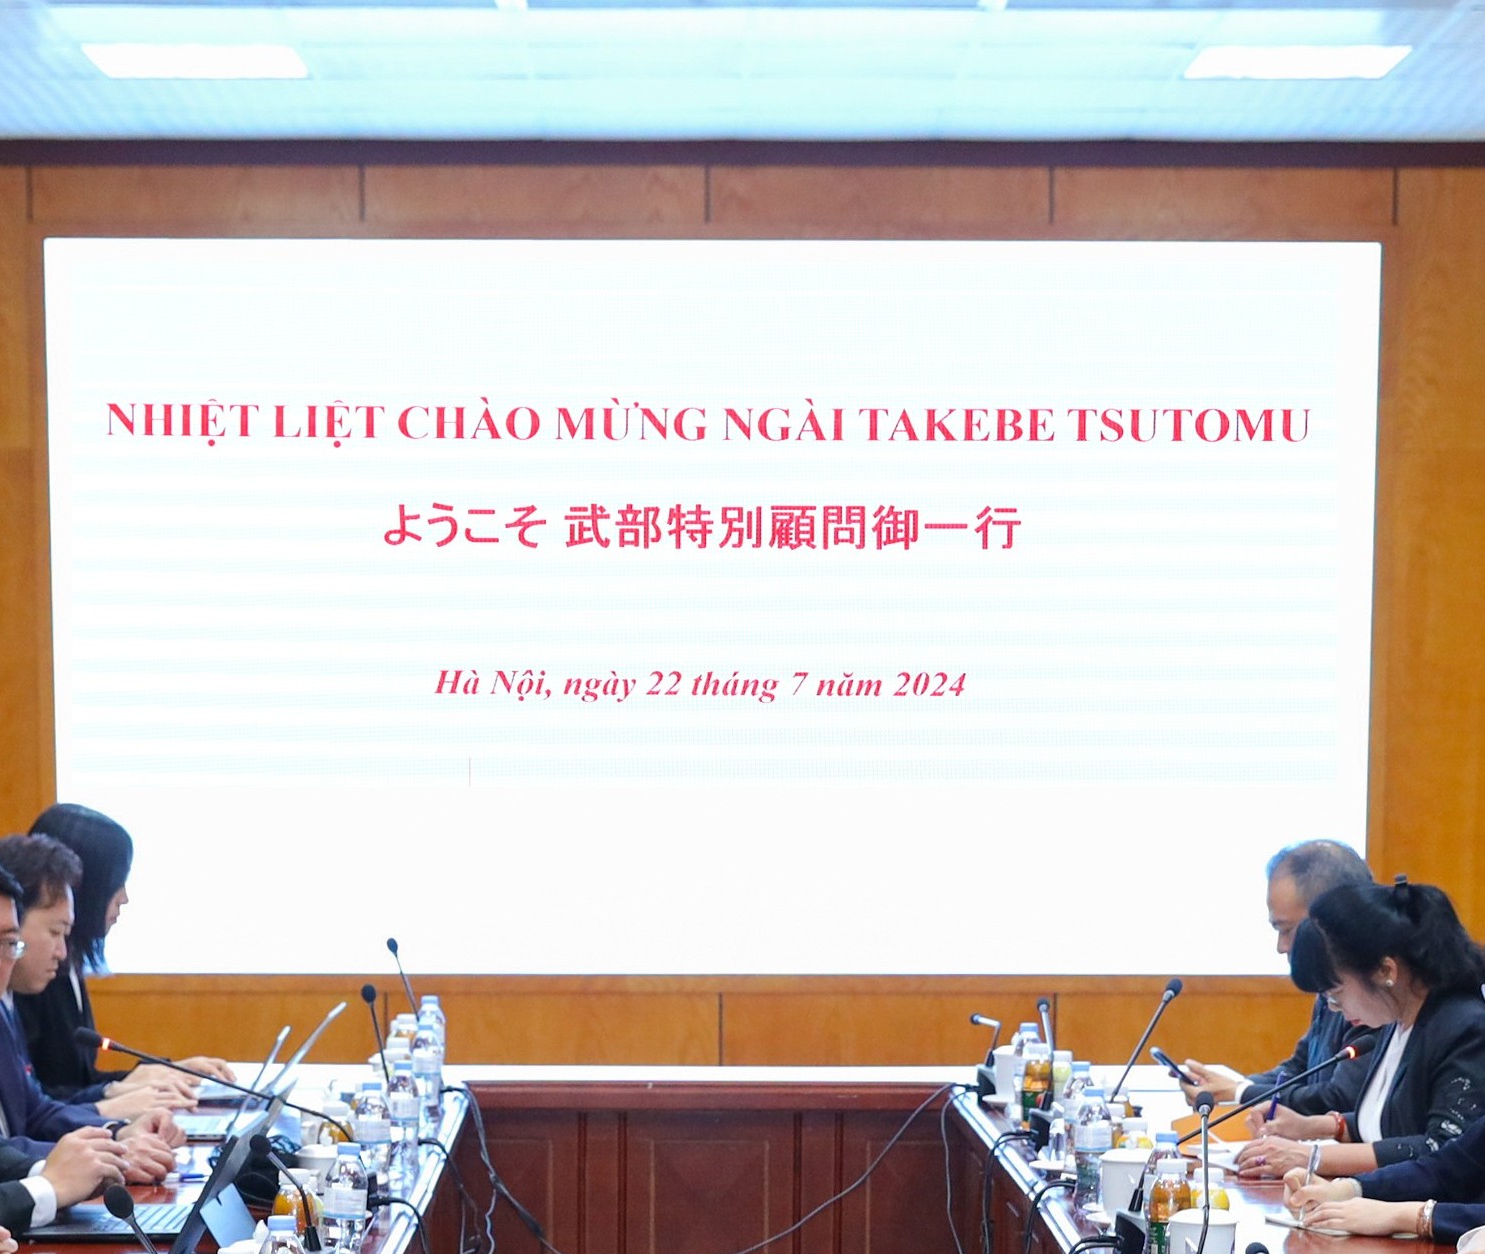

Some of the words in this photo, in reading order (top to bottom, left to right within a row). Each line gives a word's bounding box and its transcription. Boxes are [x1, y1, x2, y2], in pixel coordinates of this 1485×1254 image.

[105, 399, 260, 448] NHIỆT
[274, 399, 386, 449] LIỆT
[397, 396, 542, 441] CHÀO
[555, 398, 707, 442] MỪNG
[723, 398, 844, 443] NGÀI
[858, 407, 1056, 443] TAKEBE
[1066, 407, 1312, 444] TSUTOMU
[382, 501, 548, 549] ようこそ
[562, 503, 1024, 551] 武部特別顧問御一行
[434, 668, 480, 696] Hà
[489, 668, 552, 702] Nội,
[562, 670, 637, 703] ngày
[646, 670, 684, 696] 22
[691, 670, 780, 703] tháng
[792, 671, 814, 696] 7
[815, 671, 884, 698] năm
[893, 671, 968, 697] 2024
